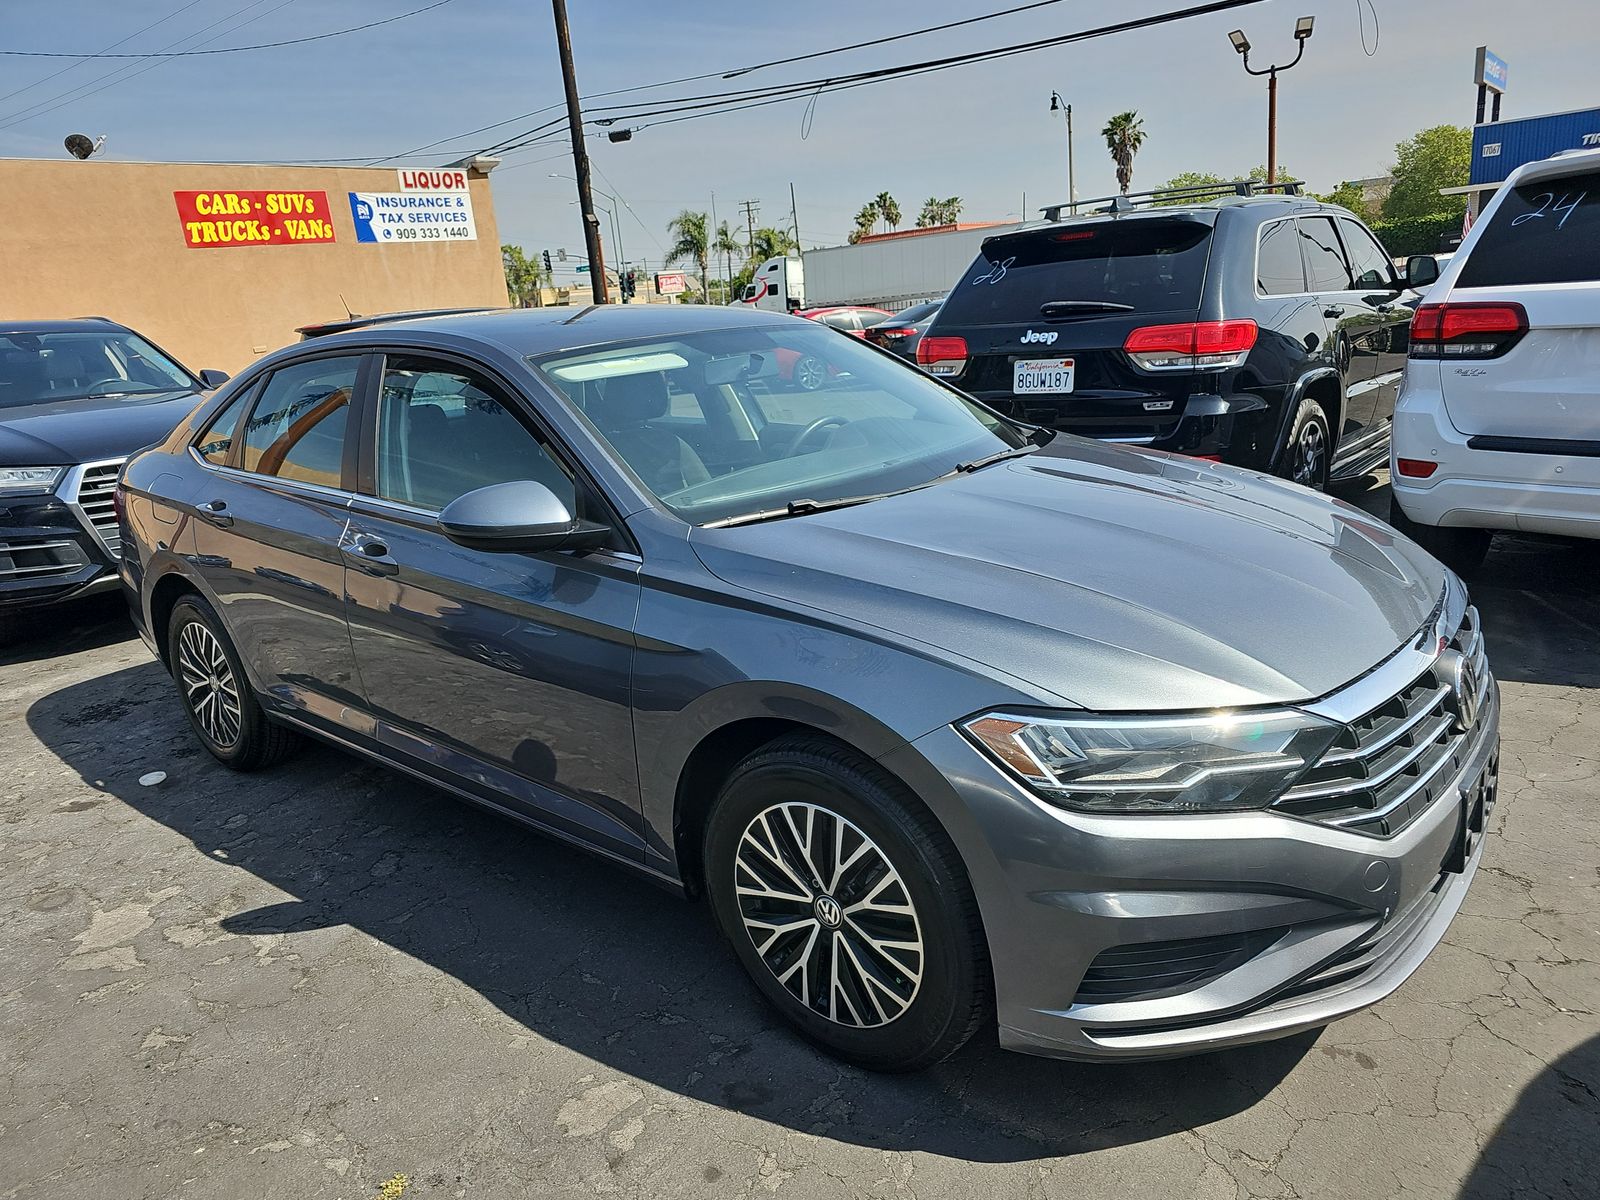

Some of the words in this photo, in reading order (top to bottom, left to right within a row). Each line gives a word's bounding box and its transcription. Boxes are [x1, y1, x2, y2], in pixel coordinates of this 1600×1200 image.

[402, 172, 466, 190] LIQUOR
[195, 193, 251, 215] CARs
[266, 193, 315, 215] SUVs
[375, 196, 452, 208] INSURANCE
[456, 197, 464, 207] &
[1511, 191, 1588, 231] 24
[379, 212, 405, 223] TAX
[408, 212, 467, 223] SERVICES
[186, 220, 271, 243] TRUCKs
[283, 219, 333, 240] VANs
[396, 228, 417, 239] 909
[419, 227, 440, 238] 333
[443, 226, 469, 238] 1440
[972, 256, 1017, 285] 28
[1020, 329, 1058, 345] Jeep
[1017, 371, 1070, 389] 8GUW187
